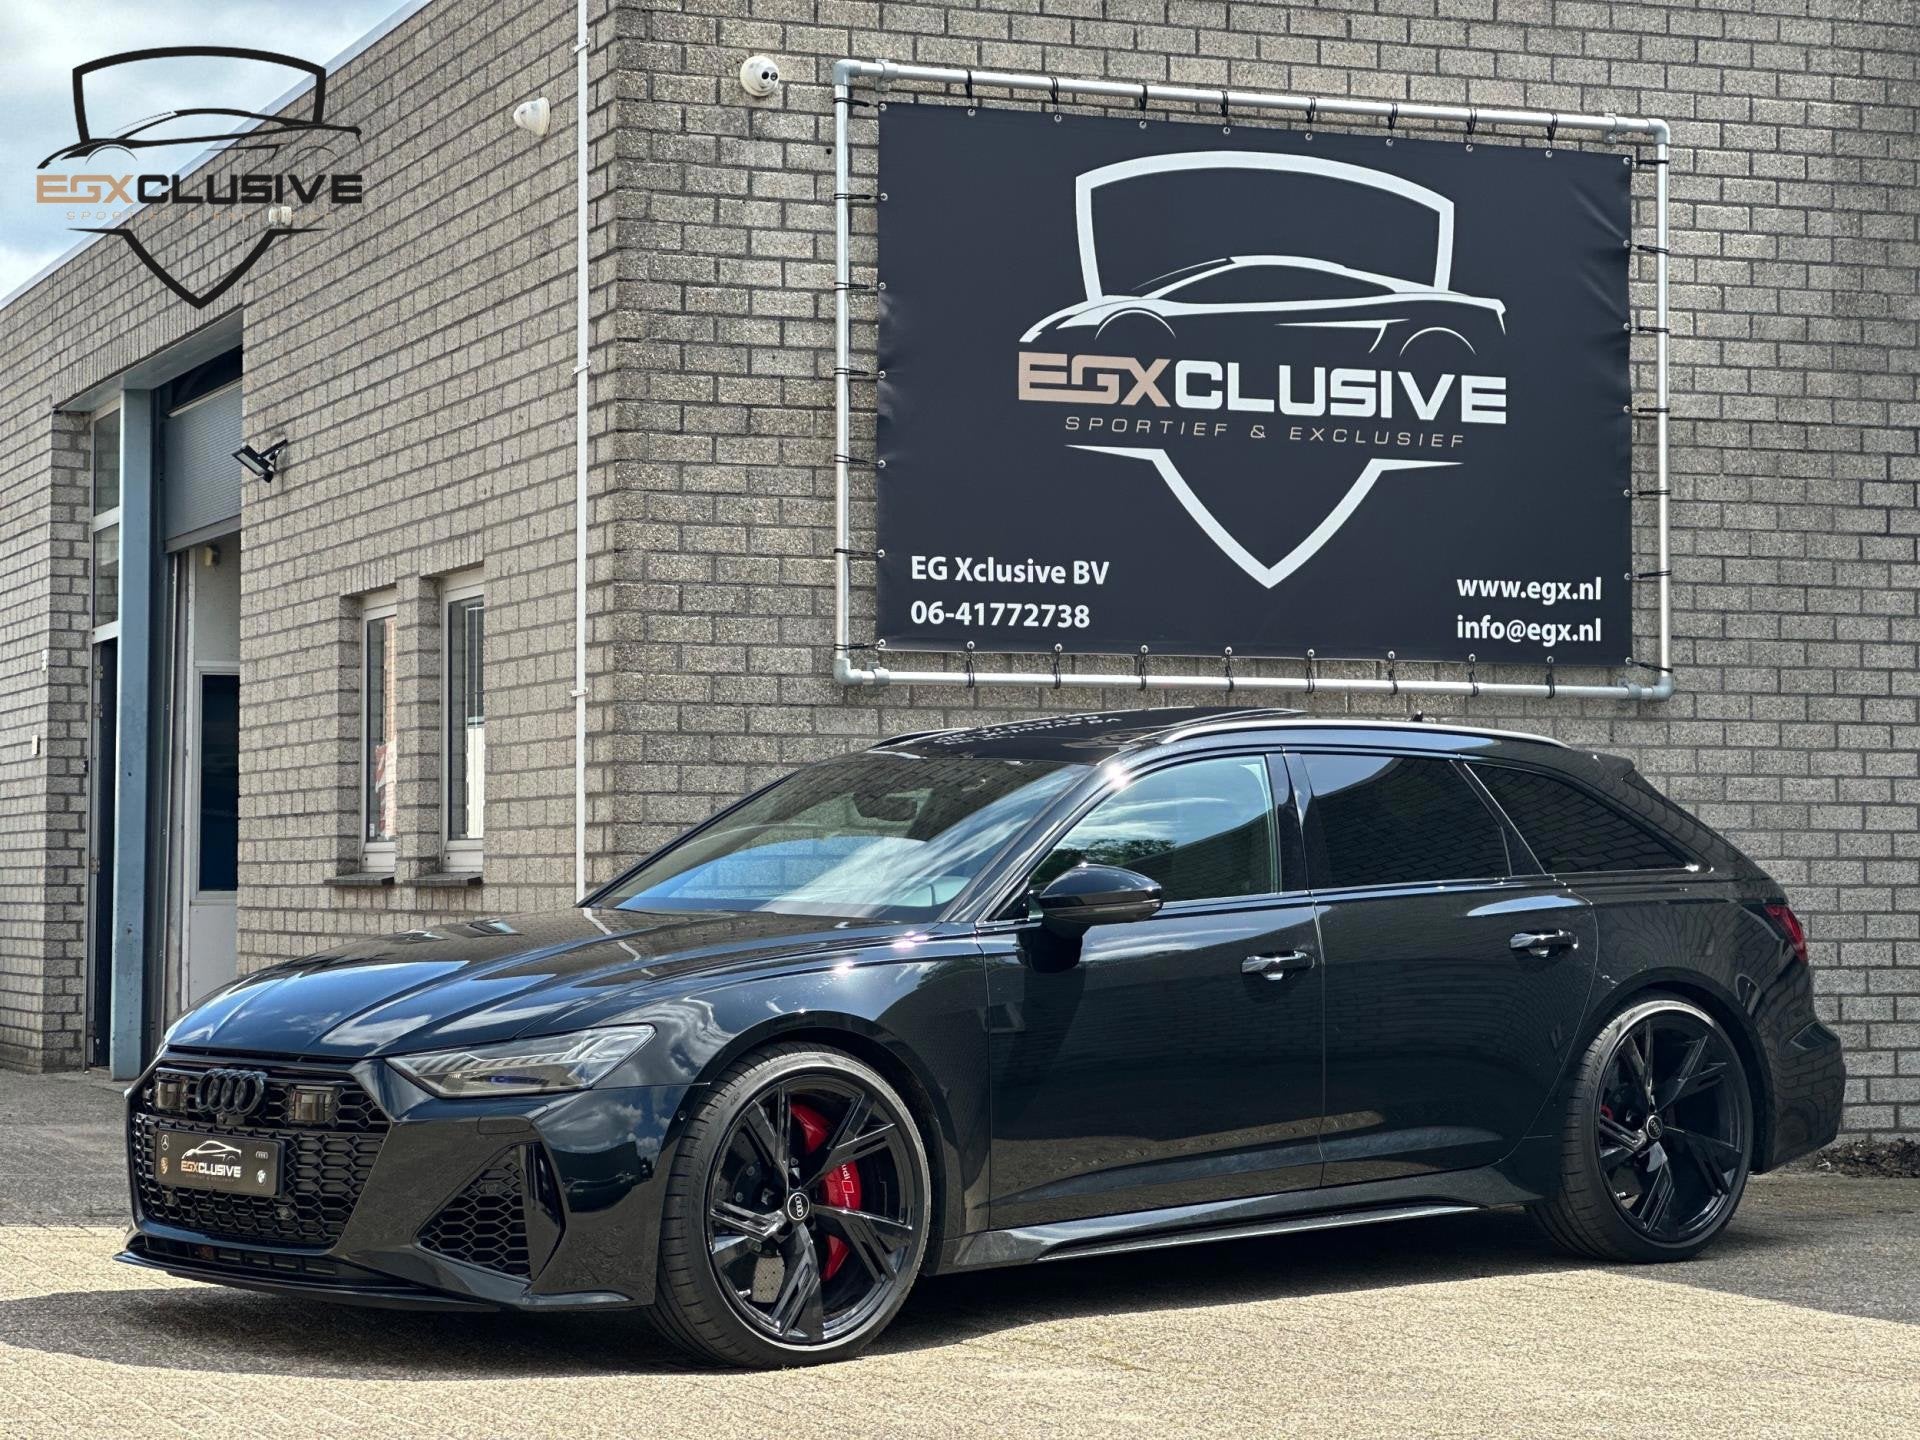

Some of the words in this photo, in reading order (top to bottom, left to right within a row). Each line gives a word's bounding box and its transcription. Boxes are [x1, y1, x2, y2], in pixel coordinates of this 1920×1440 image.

[1018, 351, 1507, 425] EGXCLUSIVE
[1065, 416, 1228, 437] SPORTIEF
[1250, 424, 1267, 439] &
[1289, 425, 1464, 448] EXCLUSIEF
[911, 555, 948, 581] EG
[954, 556, 1067, 584] Xclusive
[1073, 560, 1110, 585] BV
[1456, 576, 1602, 606] www.egx.nl
[910, 600, 1091, 628] 06-41772738
[1457, 614, 1602, 647] info@egx.nl
[180, 1160, 242, 1179] EGXCLUSIVE
